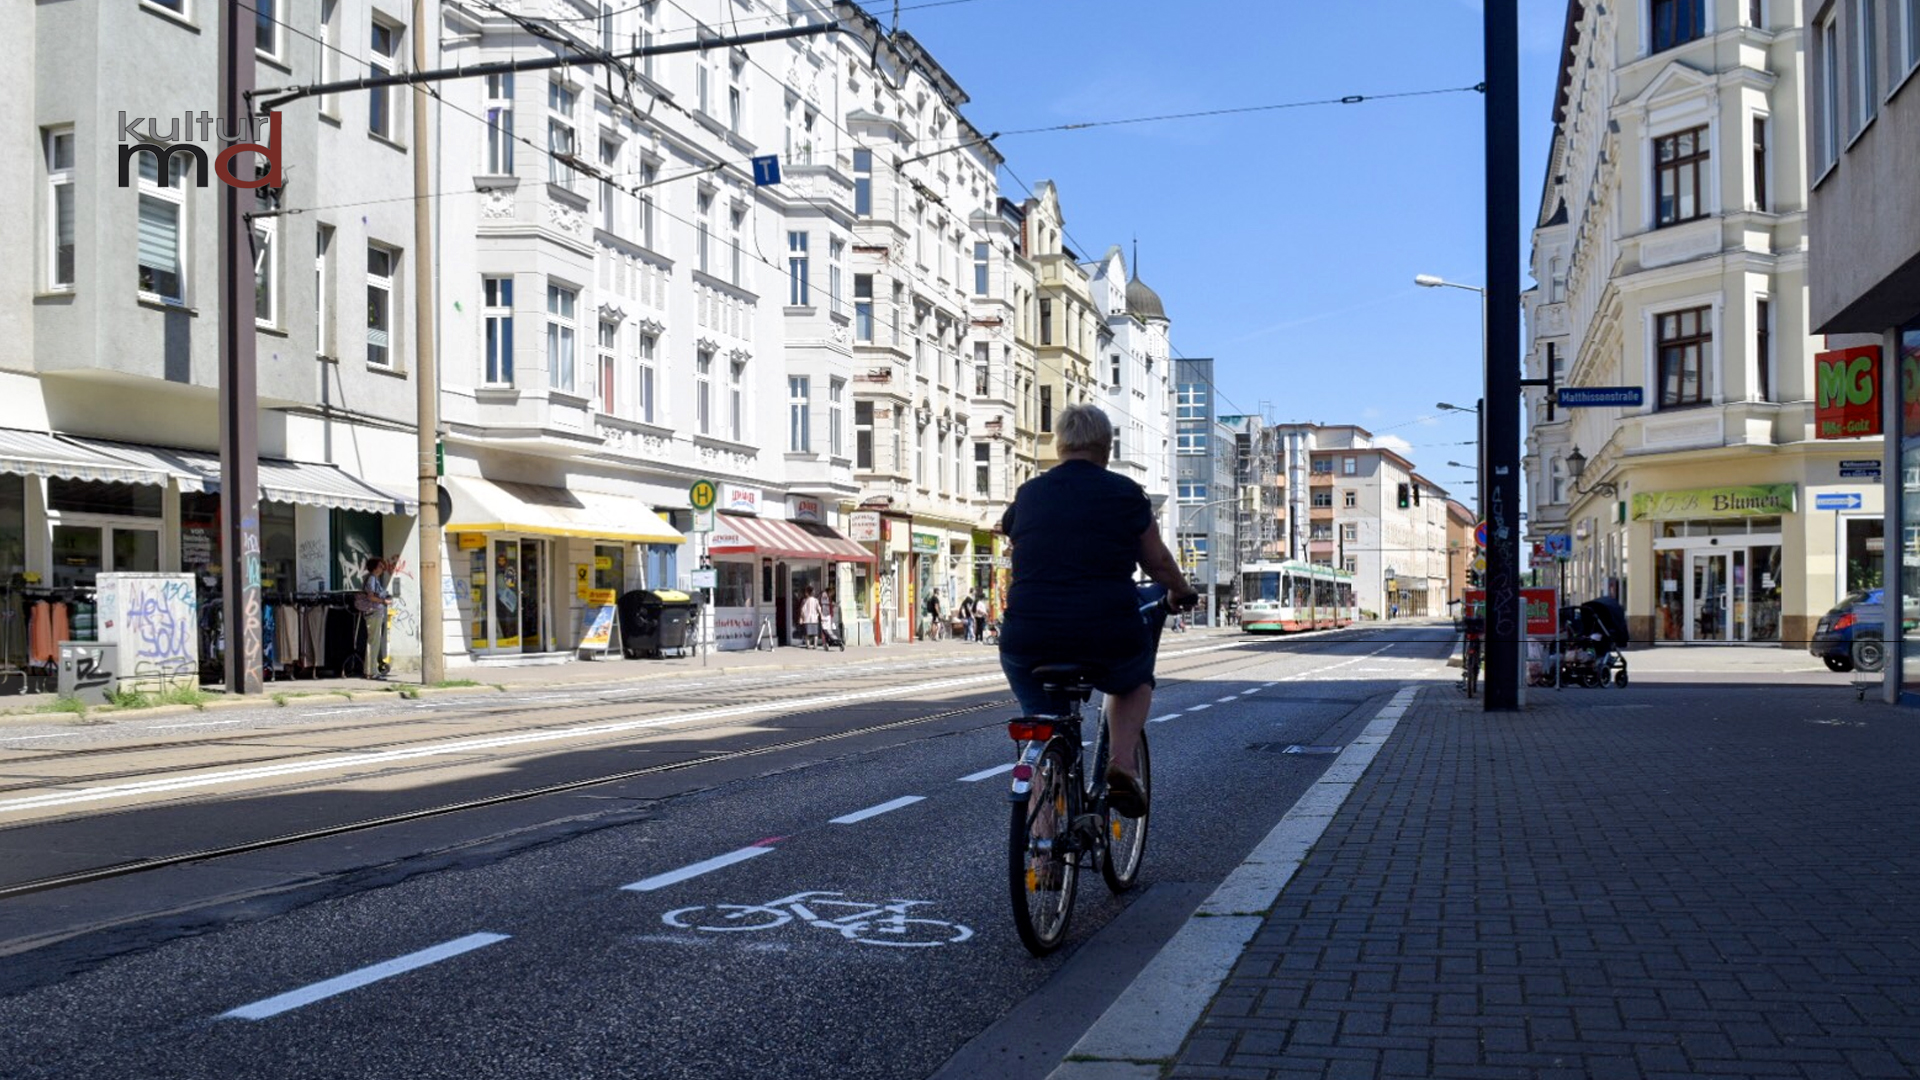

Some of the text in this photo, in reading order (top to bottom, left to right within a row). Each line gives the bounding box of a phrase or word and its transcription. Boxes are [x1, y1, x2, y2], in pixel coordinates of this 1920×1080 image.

[758, 159, 772, 182] T
[1818, 356, 1873, 408] MG
[1561, 390, 1640, 402] Matthissonstraße
[697, 486, 709, 504] H
[1712, 493, 1780, 511] Blumen
